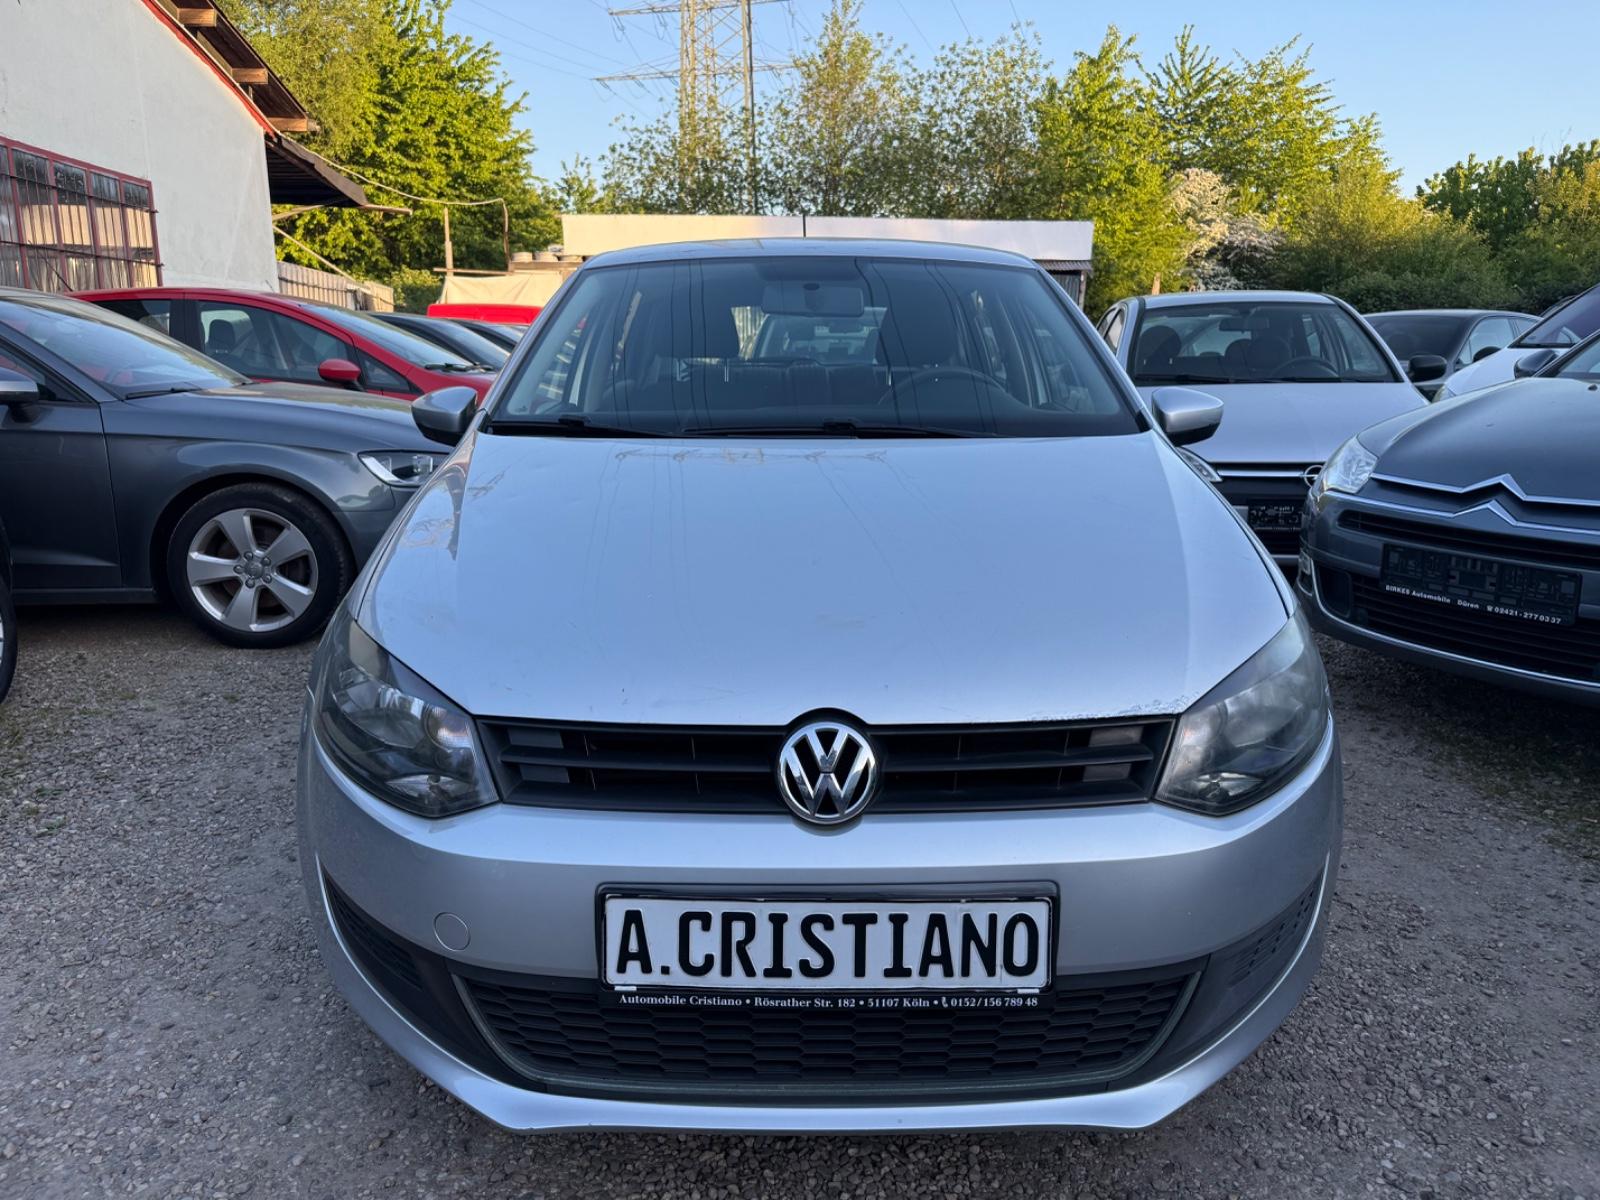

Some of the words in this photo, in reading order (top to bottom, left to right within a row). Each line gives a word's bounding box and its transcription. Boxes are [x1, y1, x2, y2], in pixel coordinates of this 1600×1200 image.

[1411, 590, 1451, 604] Automobile
[1457, 599, 1480, 609] Düren
[780, 722, 876, 825] VW
[616, 908, 1040, 979] A.CRISTIANO
[619, 994, 687, 1005] Automobile
[689, 995, 742, 1006] Cristiano
[754, 996, 812, 1008] Rösrather
[813, 998, 834, 1008] Str.
[838, 998, 856, 1008] 182
[867, 998, 899, 1007] 51107
[903, 997, 930, 1007] Köln
